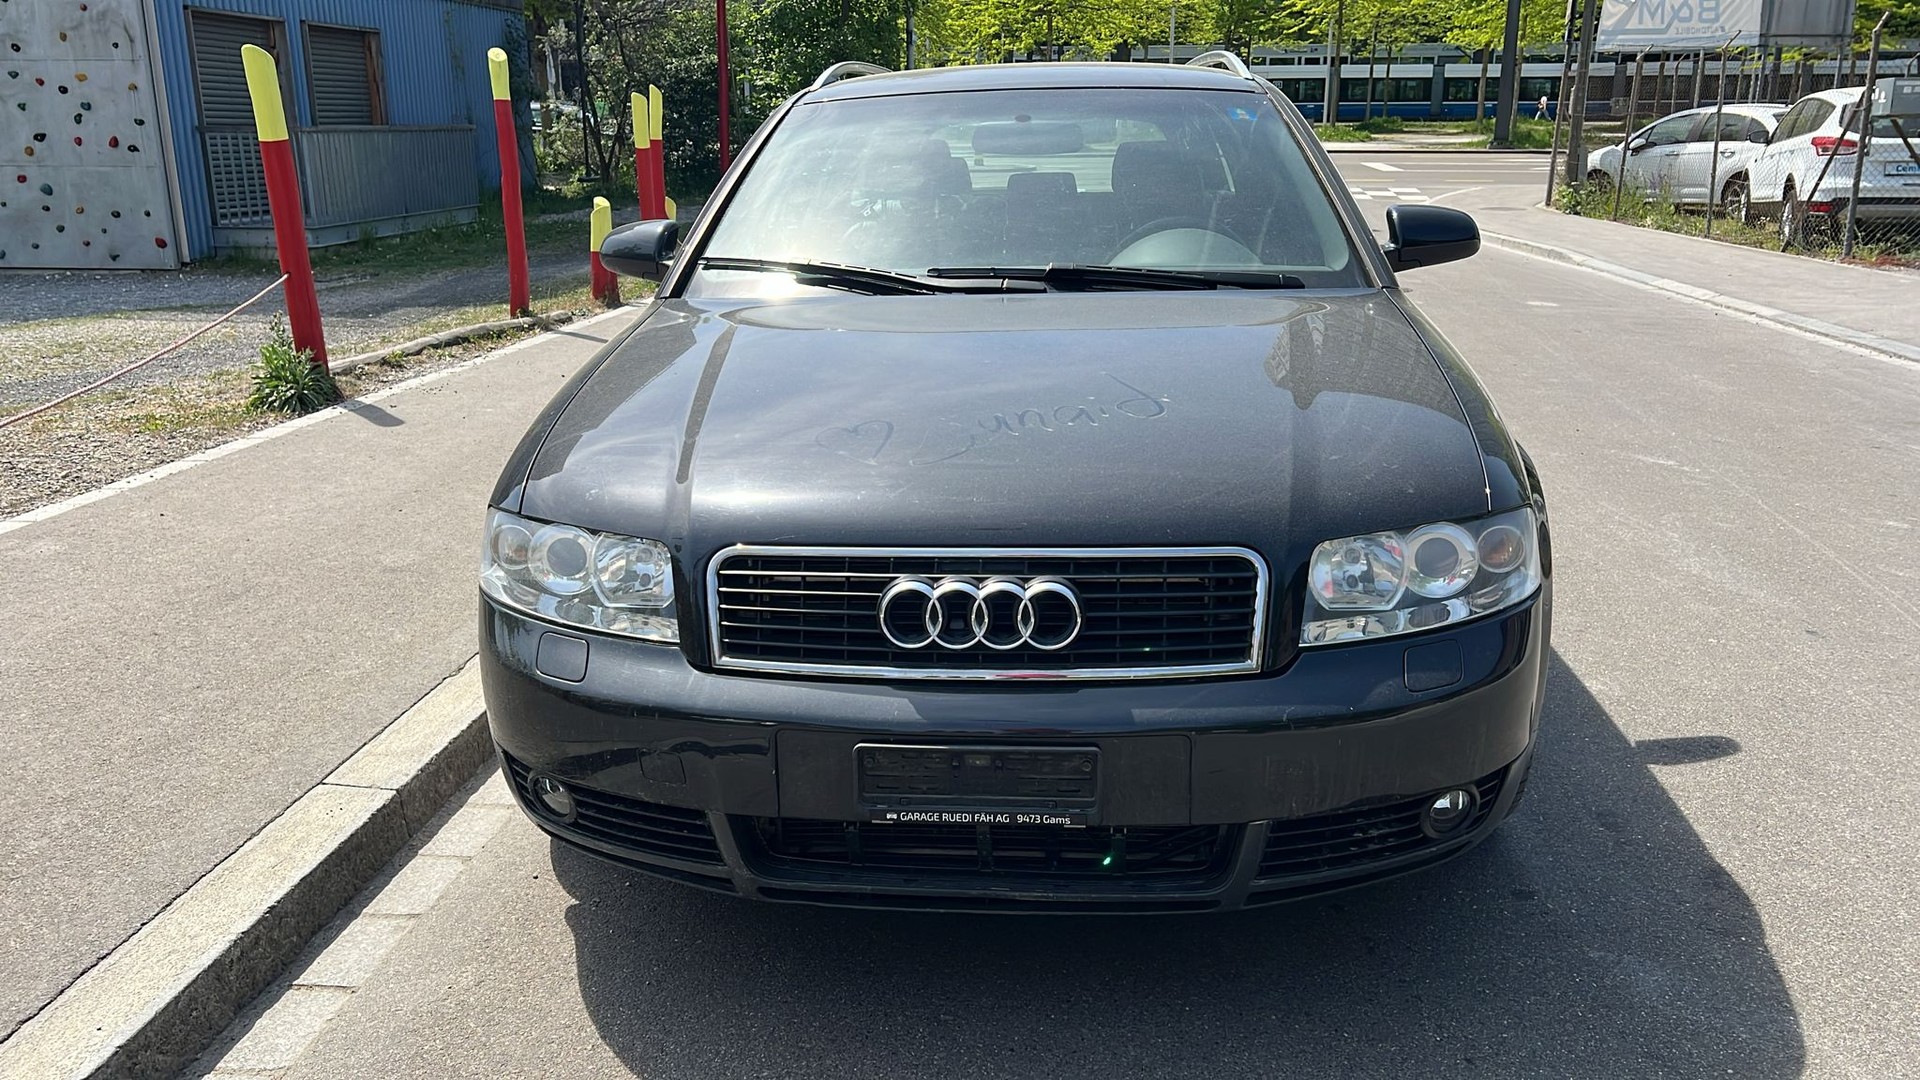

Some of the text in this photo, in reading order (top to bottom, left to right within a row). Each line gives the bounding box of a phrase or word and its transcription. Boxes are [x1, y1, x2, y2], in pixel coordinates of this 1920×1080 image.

[900, 812, 1071, 825] GARAGE RUEDI FÄH AG 9473 Gams
